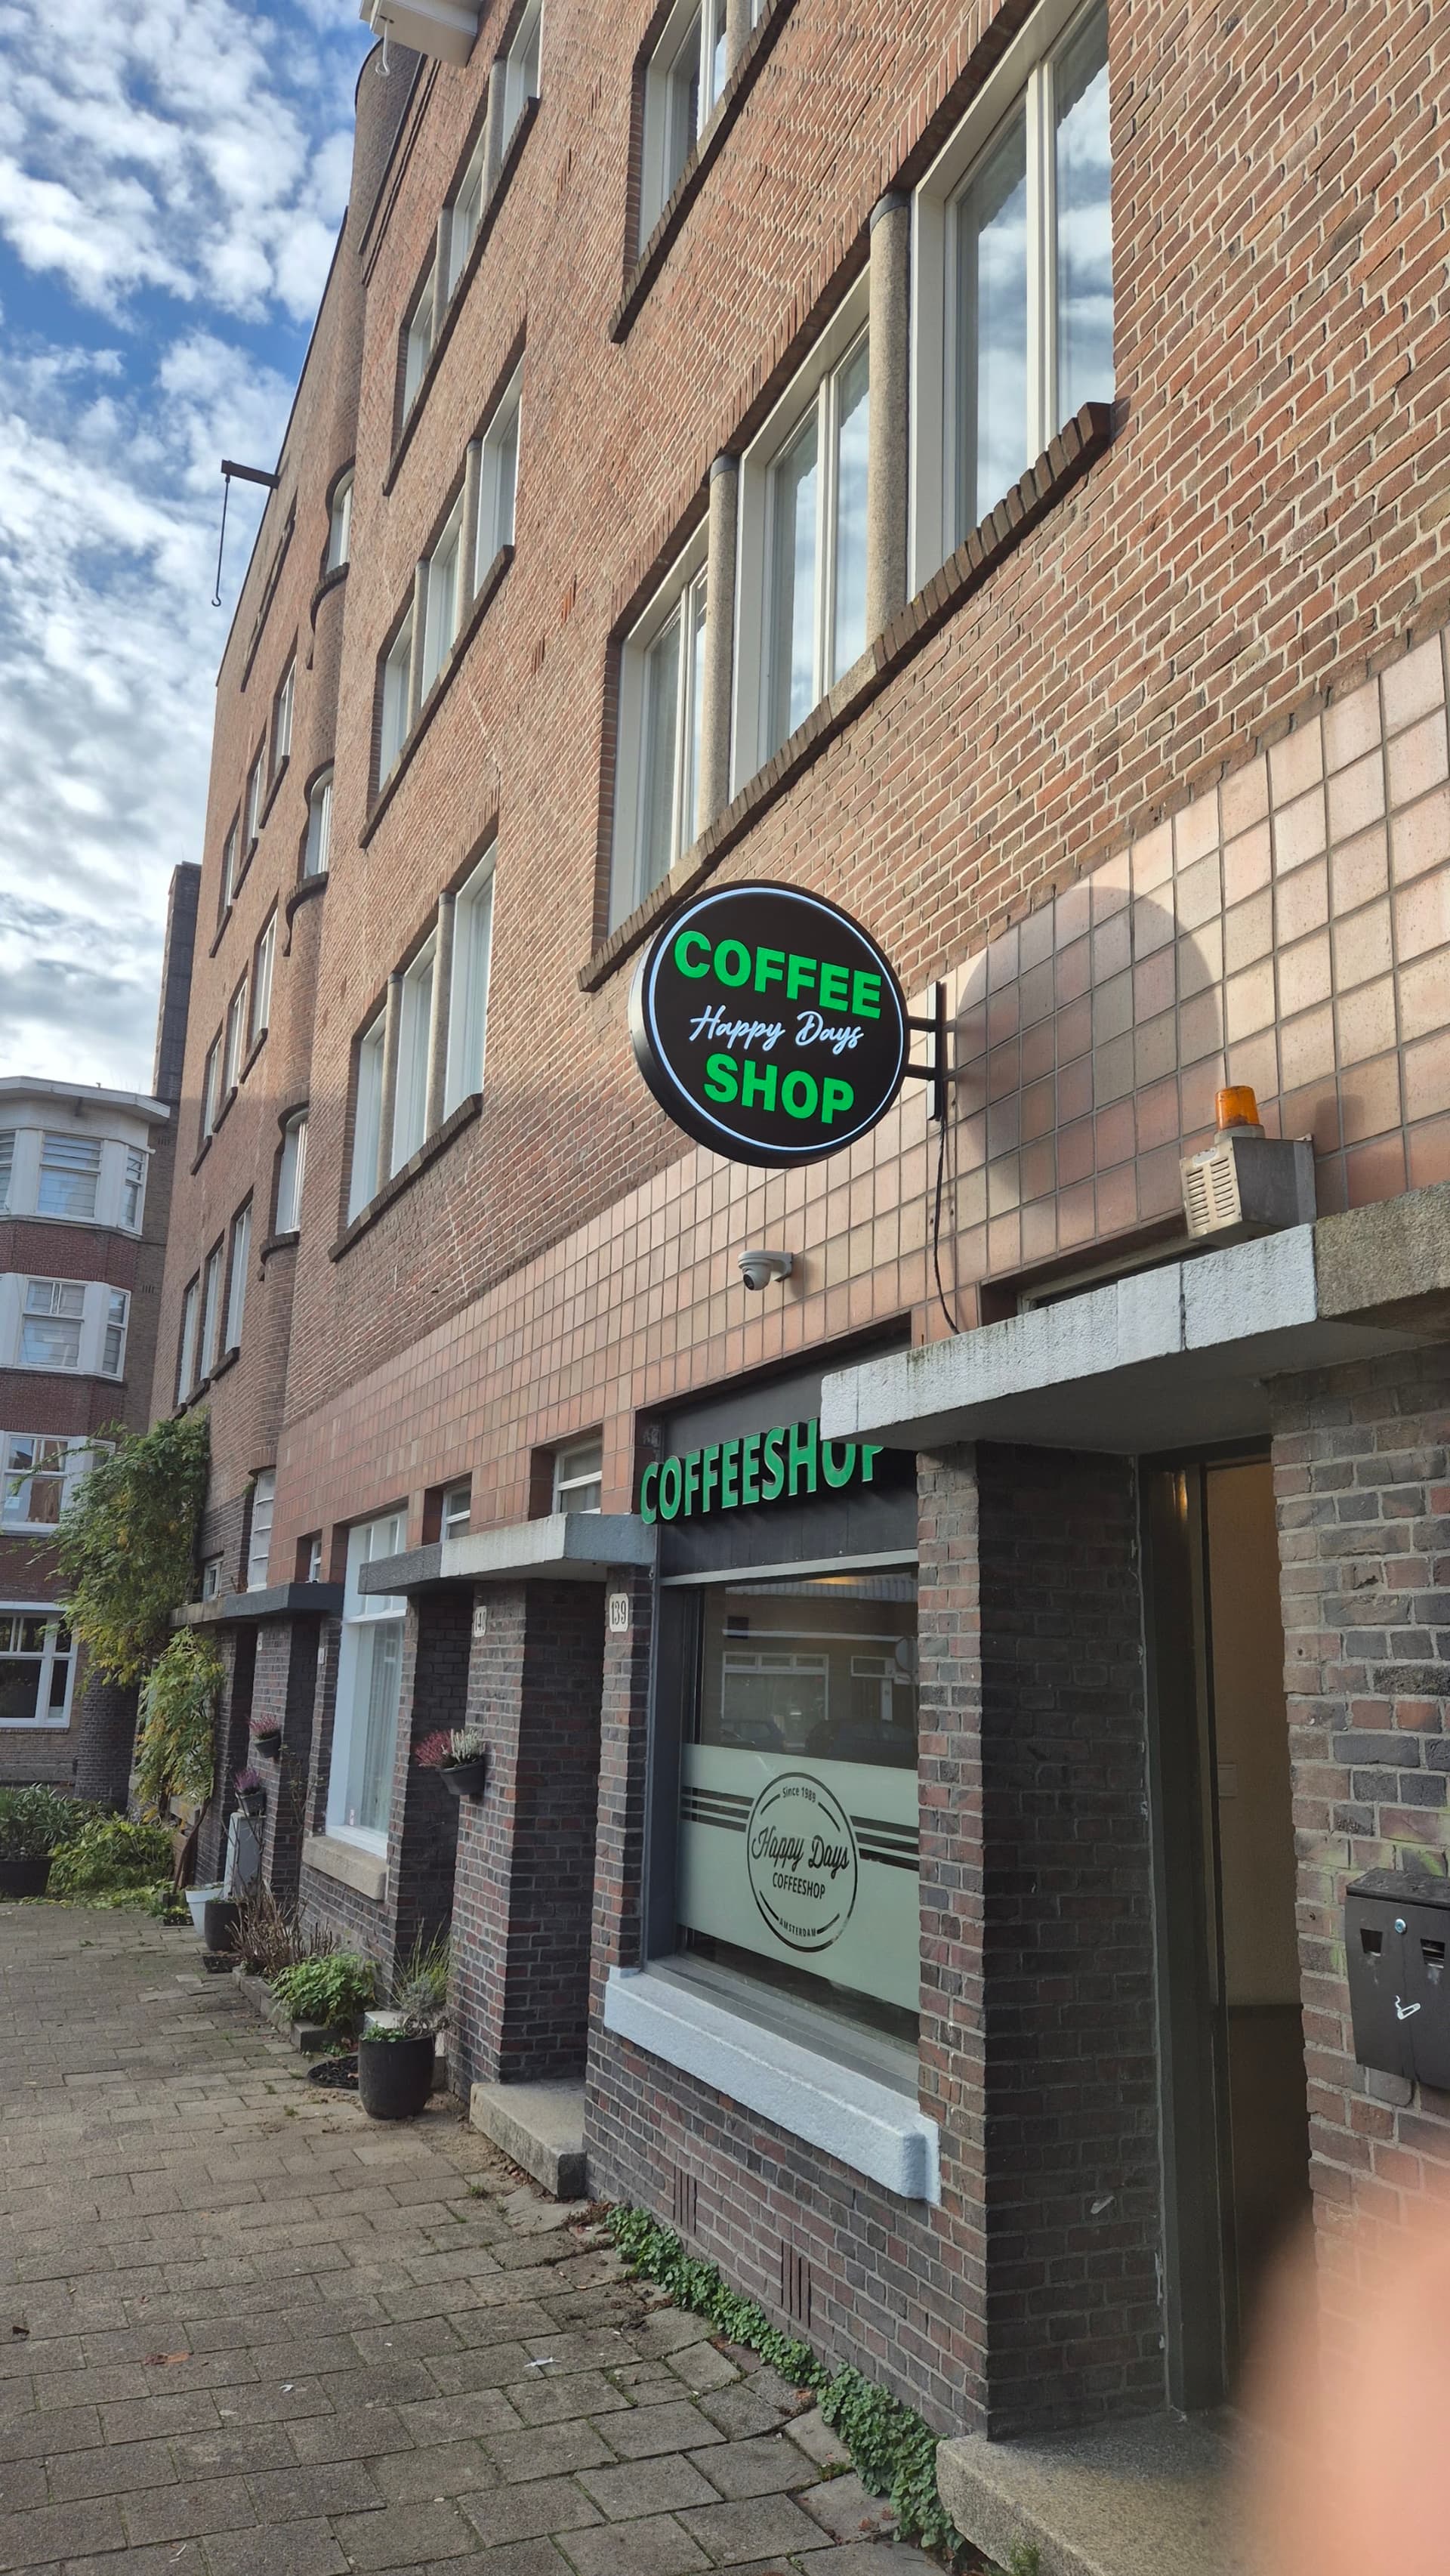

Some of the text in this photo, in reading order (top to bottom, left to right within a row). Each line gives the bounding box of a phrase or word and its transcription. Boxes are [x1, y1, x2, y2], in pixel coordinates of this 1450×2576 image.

[674, 930, 882, 1019] COFFEE
[689, 1005, 865, 1056] Happy Days
[703, 1052, 855, 1124] SHOP
[611, 1600, 627, 1625] 139
[782, 1787, 799, 1798] Since
[751, 1825, 850, 1879] Happy Days
[773, 1872, 825, 1899] COFFEESHOP
[779, 1917, 816, 1937] AMSTERDAM
